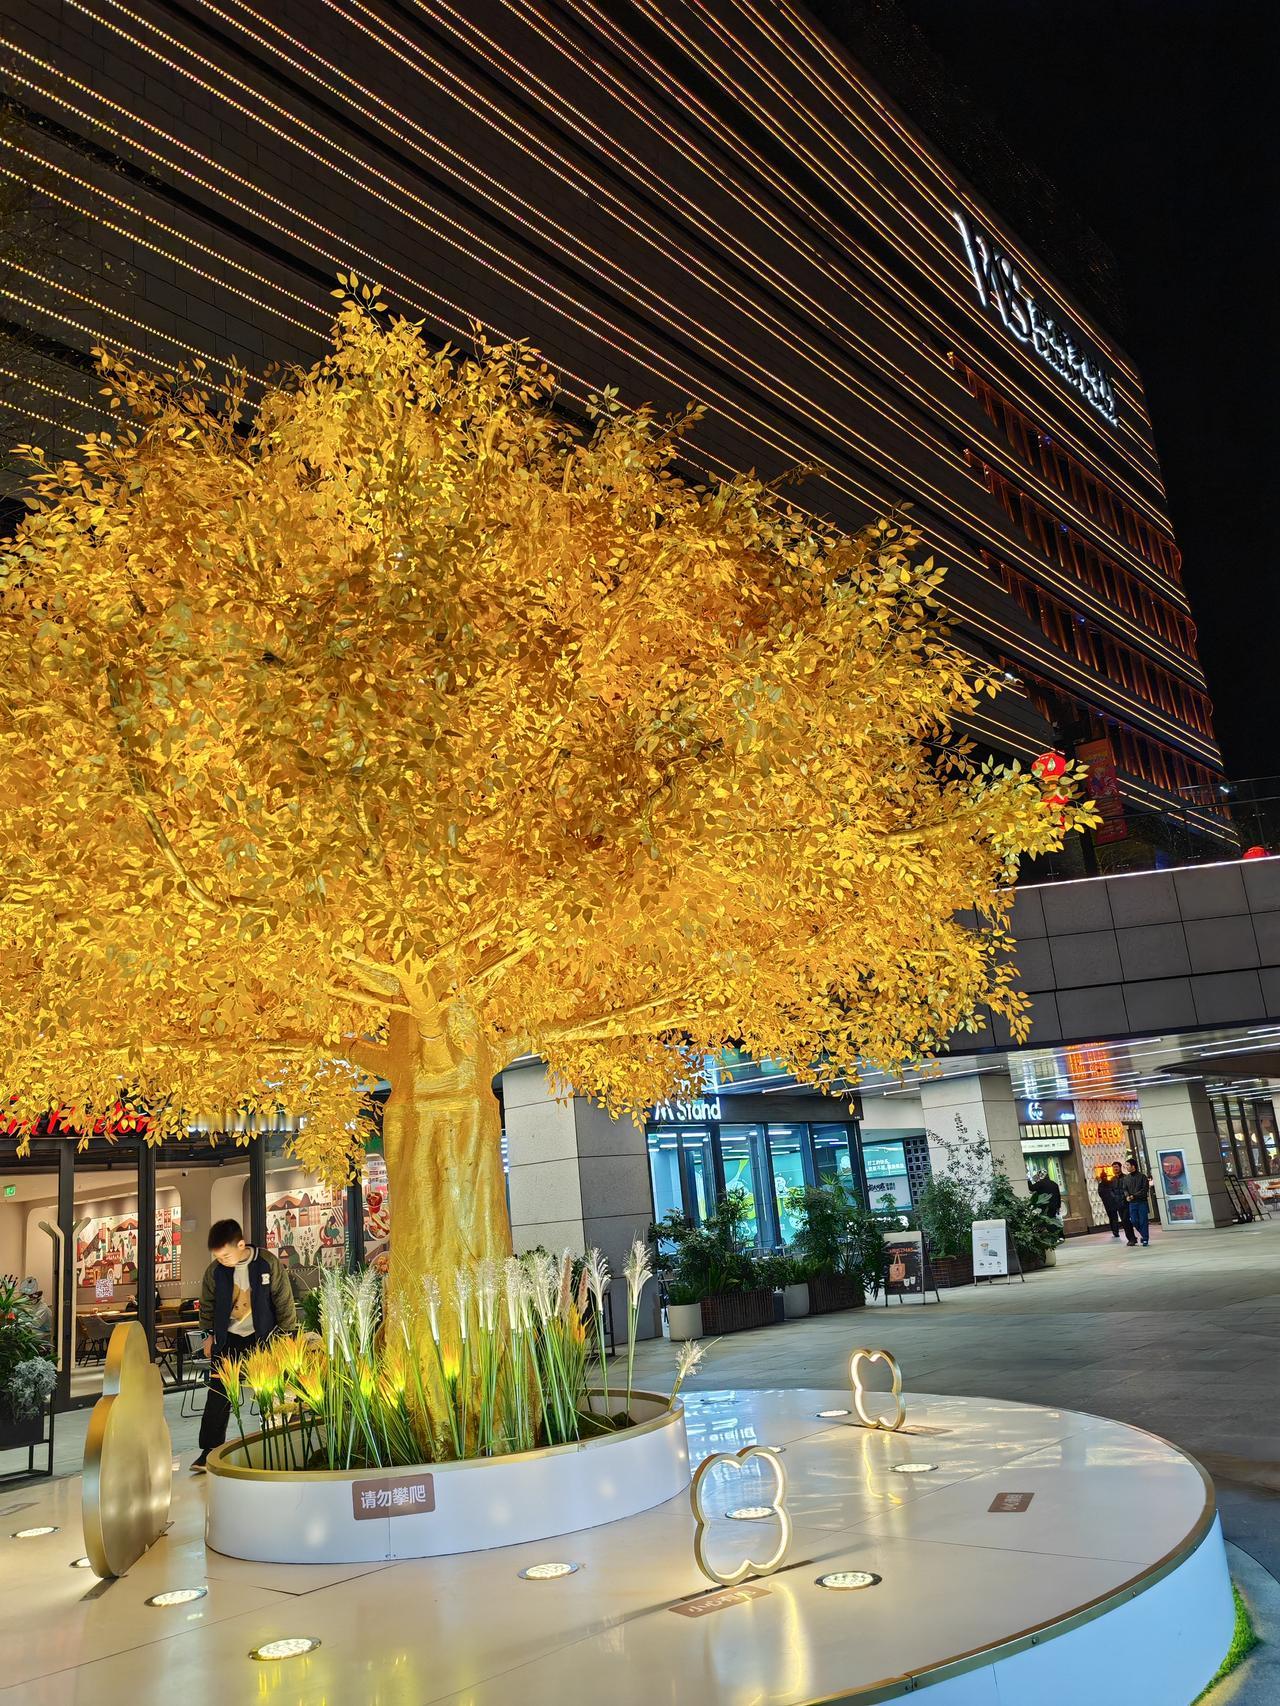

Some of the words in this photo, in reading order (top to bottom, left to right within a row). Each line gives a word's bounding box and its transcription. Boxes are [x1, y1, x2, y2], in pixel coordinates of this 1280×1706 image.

[655, 1098, 675, 1121] M
[677, 1096, 722, 1121] Stand
[361, 1485, 427, 1509] 请勿攀爬
